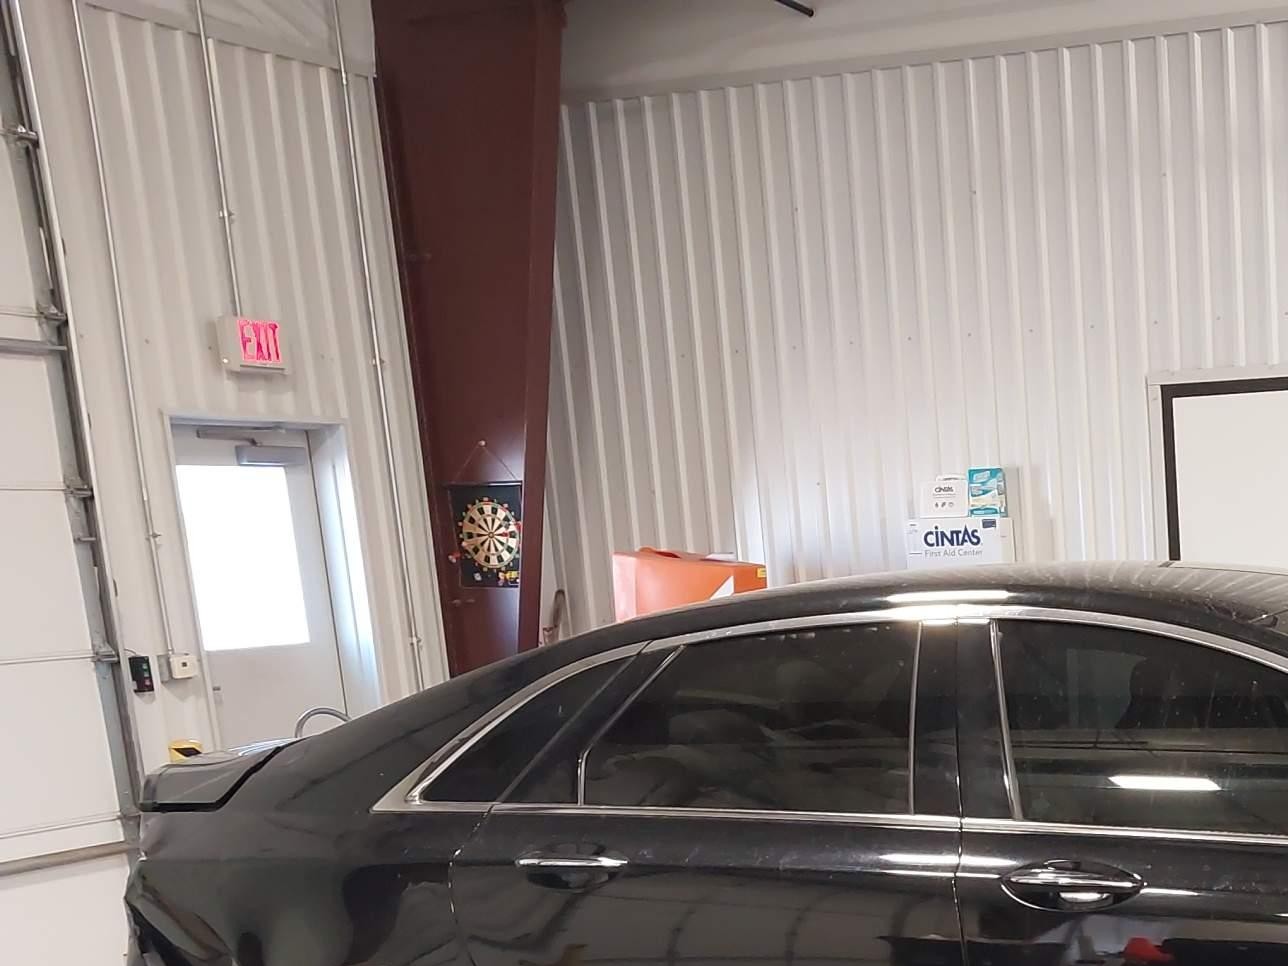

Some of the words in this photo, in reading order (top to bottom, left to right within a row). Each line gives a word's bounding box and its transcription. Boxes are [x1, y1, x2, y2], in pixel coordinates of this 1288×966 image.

[239, 320, 281, 362] EXIT
[924, 524, 981, 547] CINTAS
[958, 548, 983, 556] Center
